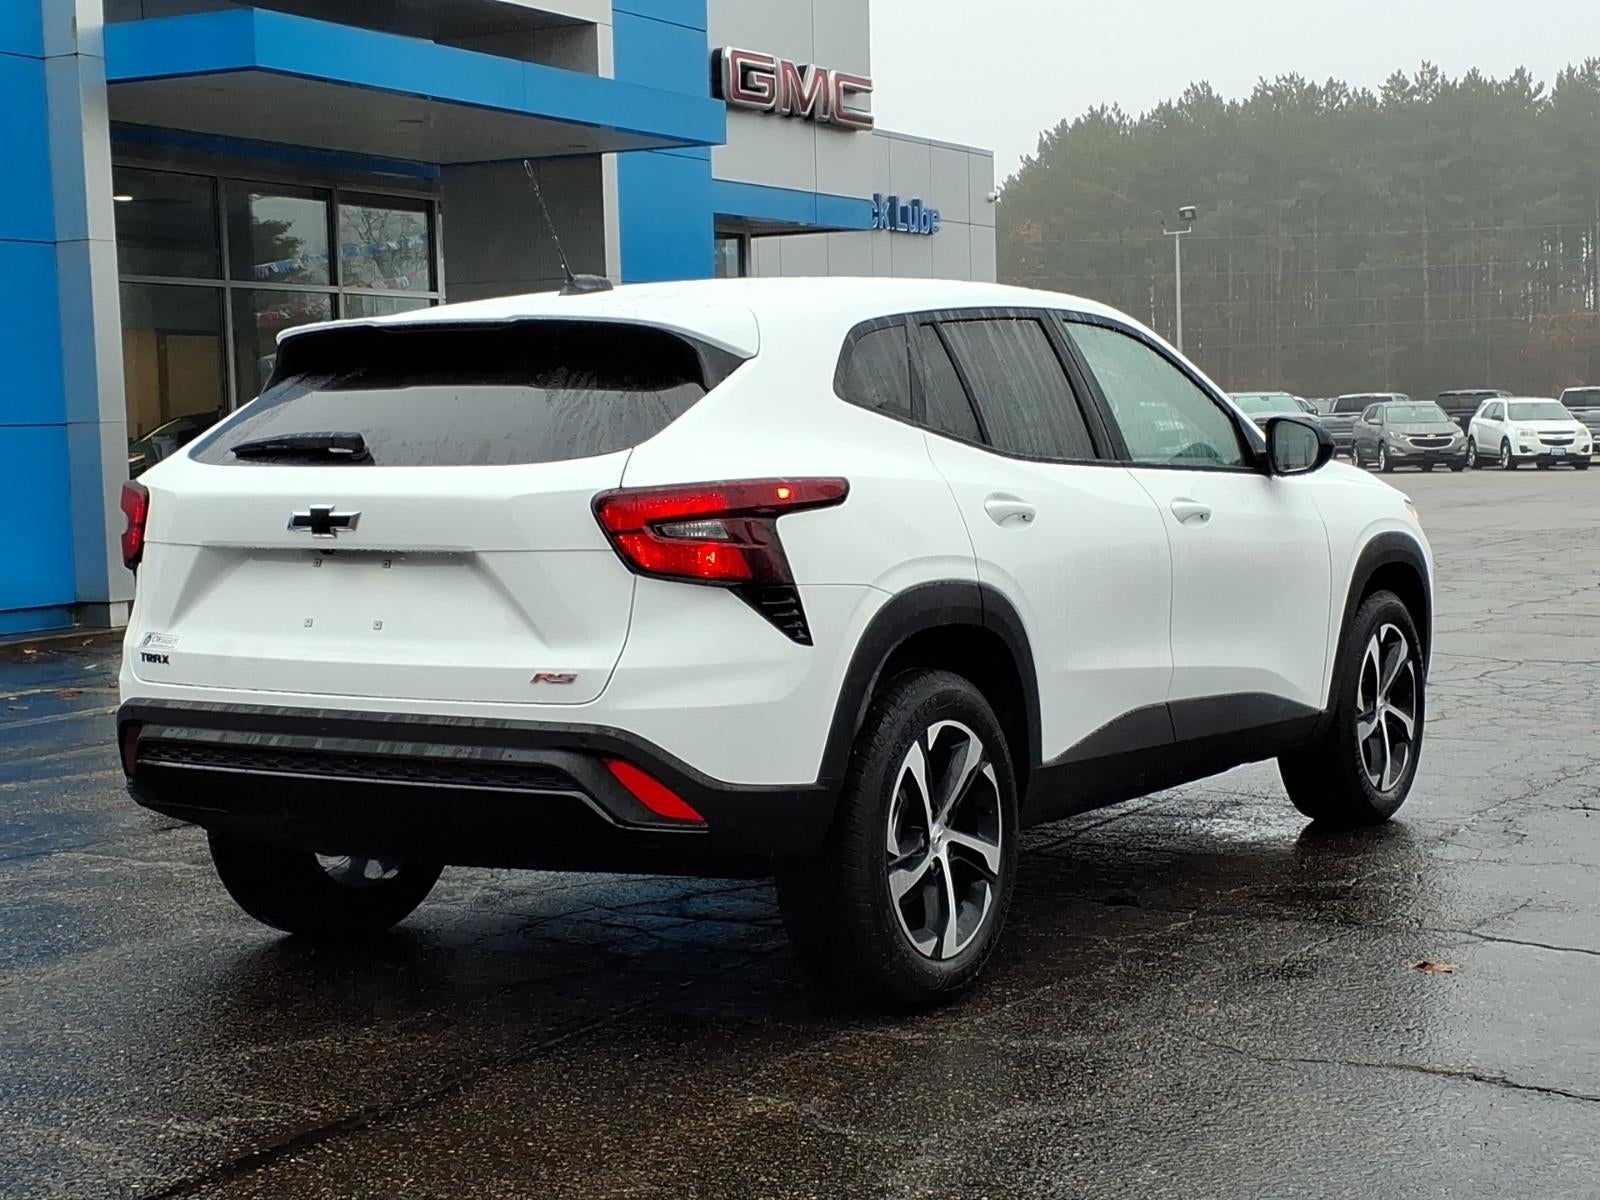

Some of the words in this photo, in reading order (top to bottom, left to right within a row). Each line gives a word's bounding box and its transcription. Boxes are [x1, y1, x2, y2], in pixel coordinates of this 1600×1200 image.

[718, 46, 874, 131] GMC
[891, 195, 941, 235] Lube
[140, 652, 170, 665] TRAX
[529, 672, 578, 685] RS
